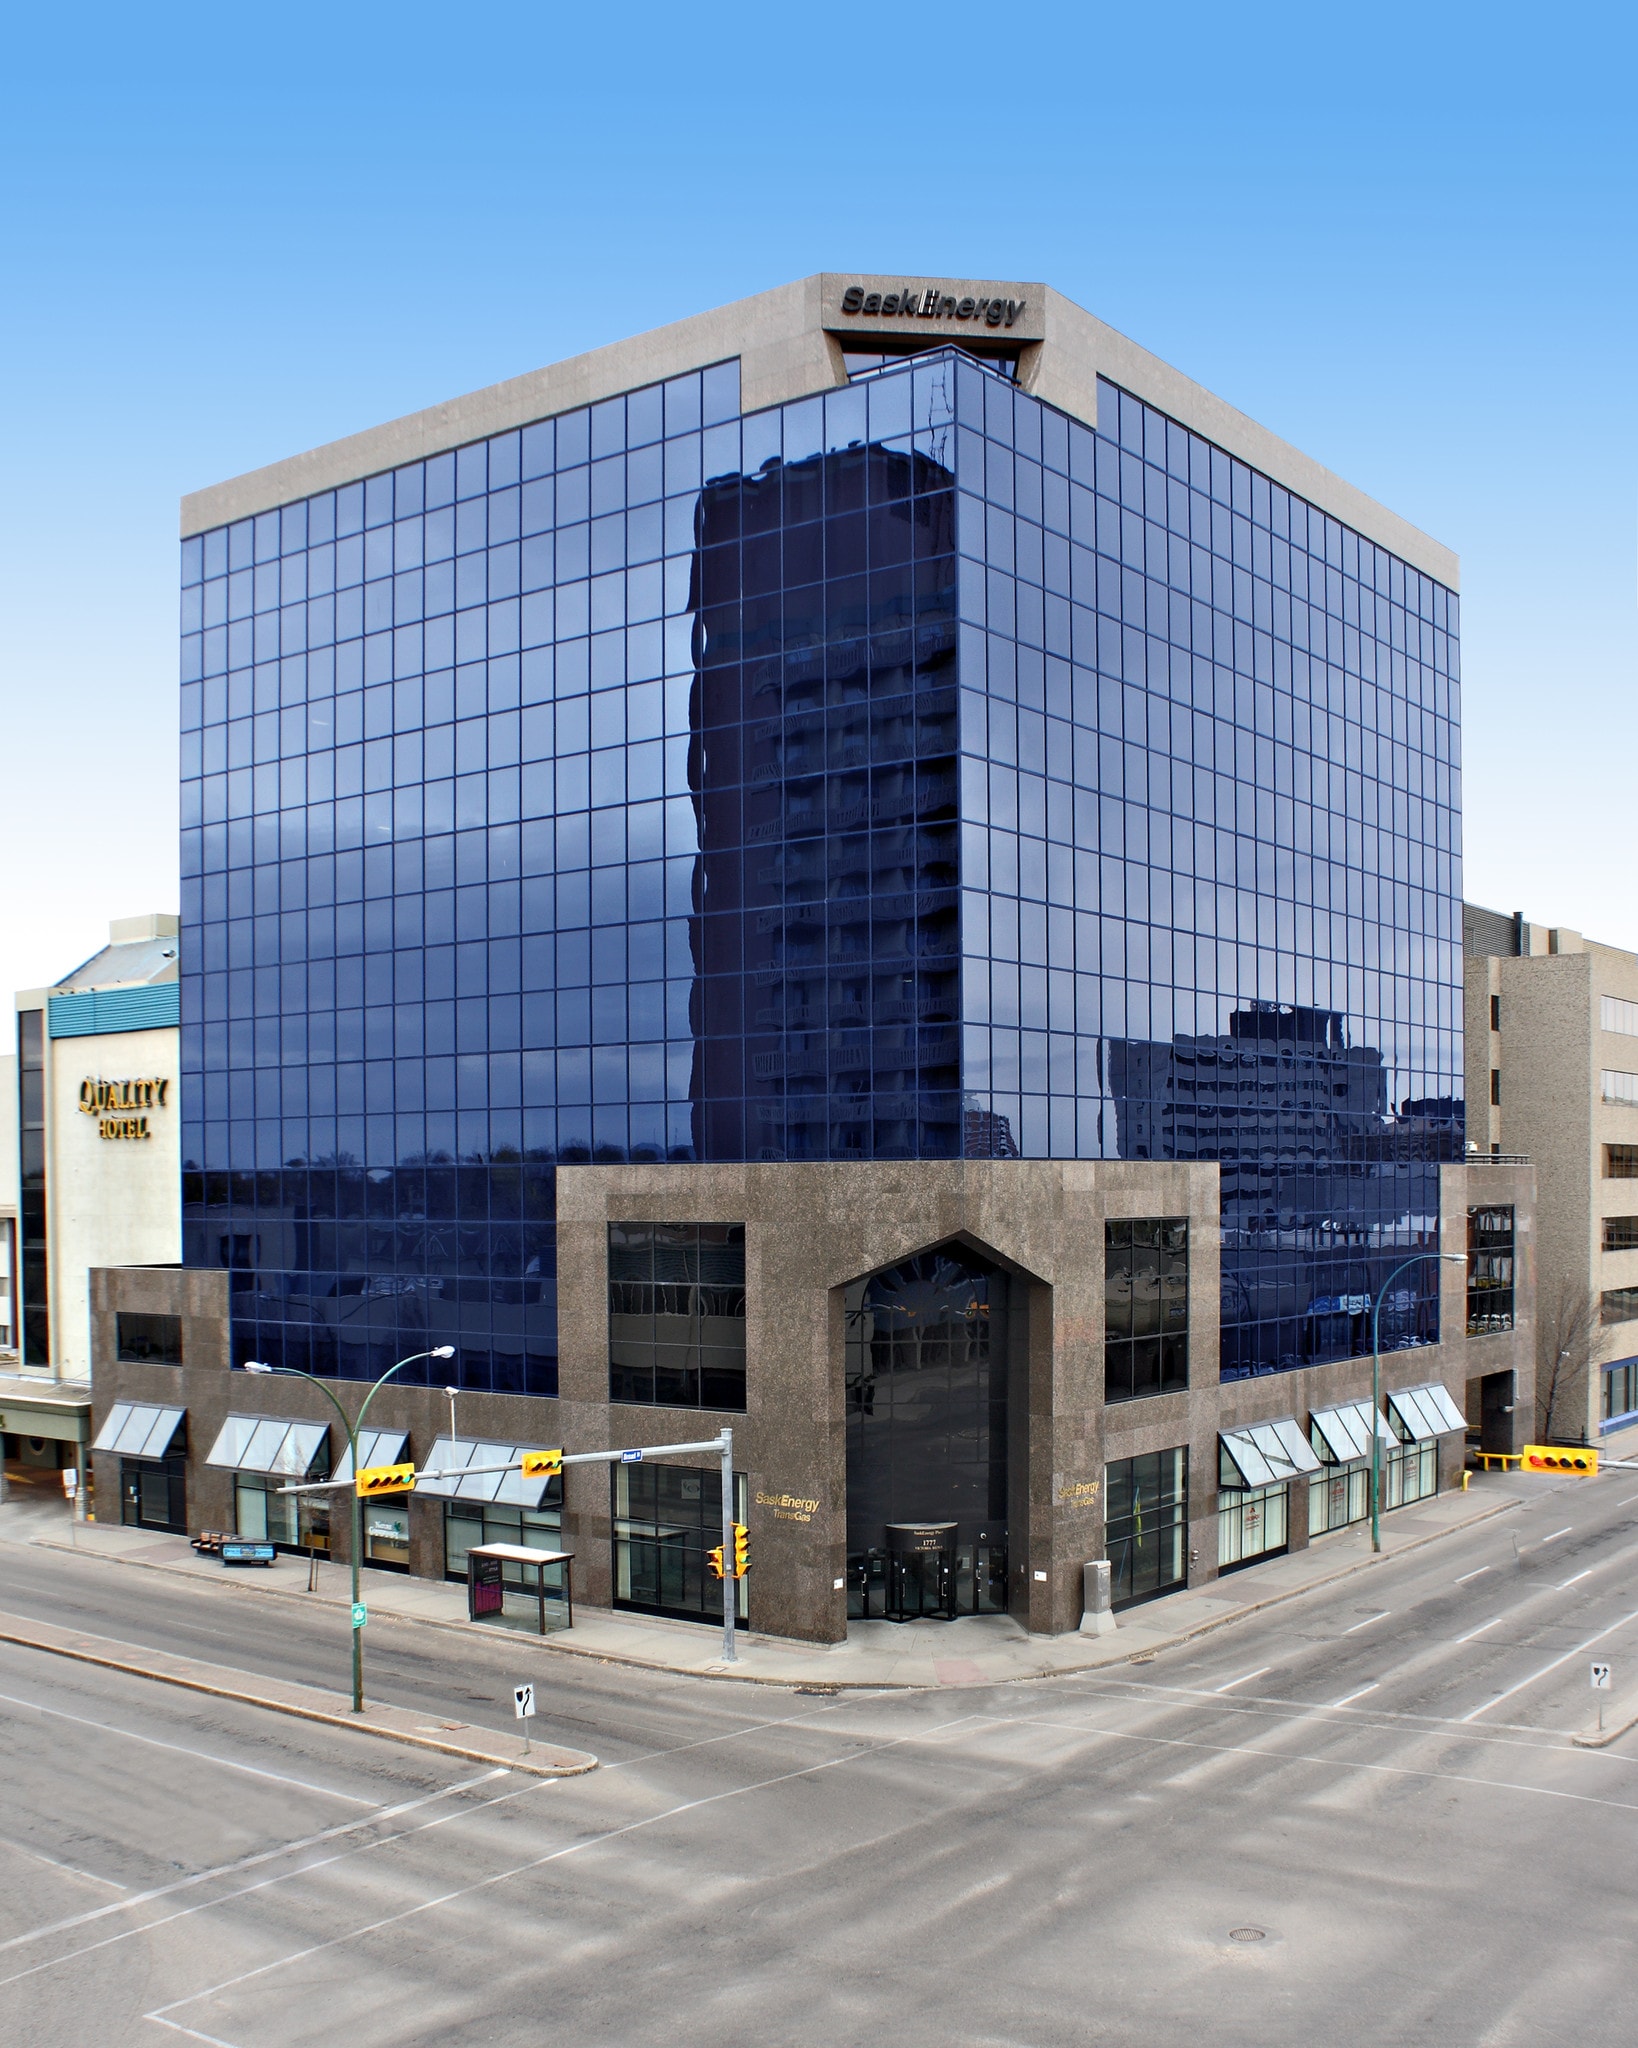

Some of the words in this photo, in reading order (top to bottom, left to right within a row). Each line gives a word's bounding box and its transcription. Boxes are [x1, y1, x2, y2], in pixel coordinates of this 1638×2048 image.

[841, 286, 1027, 327] SaskEnergy
[79, 1078, 168, 1116] QUALITY
[99, 1117, 150, 1139] HOTEL
[755, 1491, 820, 1513] SaskEnergy
[773, 1508, 812, 1522] TransGas
